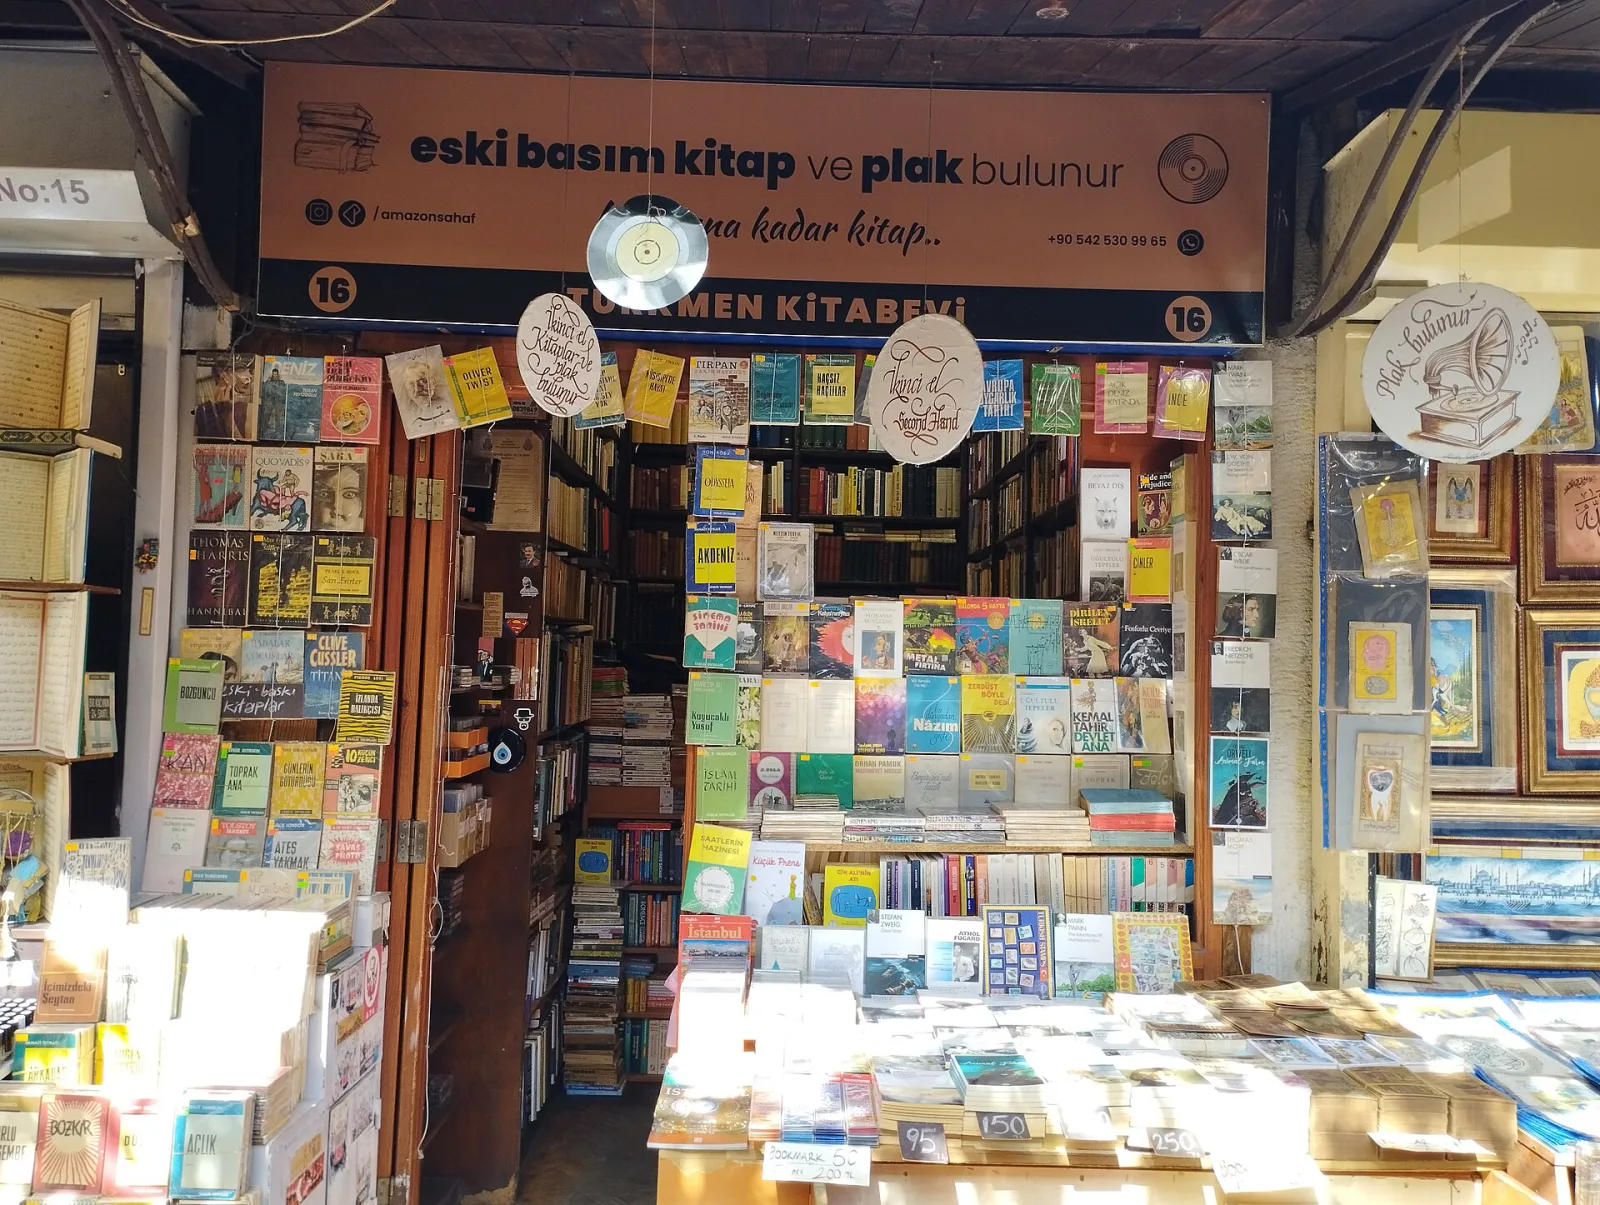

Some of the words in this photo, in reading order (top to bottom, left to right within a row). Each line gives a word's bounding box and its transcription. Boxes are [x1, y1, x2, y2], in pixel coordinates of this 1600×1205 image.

[410, 128, 508, 168] eski
[517, 132, 665, 174] basım
[674, 137, 795, 190] kitap
[807, 155, 853, 181] ve
[861, 148, 964, 193] plak
[972, 153, 1124, 188] bulunur
[0, 177, 90, 205] No:15
[373, 205, 476, 225] /amazonsahaf
[751, 206, 838, 243] kadar
[1047, 234, 1073, 245] +90
[1076, 234, 1101, 246] 542
[1103, 234, 1128, 247] 530
[1131, 235, 1148, 247] 99
[1151, 235, 1167, 248] 65
[314, 277, 350, 304] 16
[1172, 306, 1206, 333] 16
[1376, 350, 1420, 400] Plak
[1398, 300, 1486, 353] bulunur
[696, 361, 738, 370] TIRPAN
[533, 362, 590, 405] bulunur
[893, 406, 930, 434] Second
[928, 406, 961, 433] Hand
[255, 457, 279, 466] QUO
[1159, 472, 1172, 481] and
[1088, 482, 1110, 490] BEYAZ
[190, 536, 244, 548] THOMAS
[196, 550, 249, 562] HARRIS
[698, 545, 735, 564] AKDENİZ
[187, 606, 247, 616] HANNIBAL
[693, 622, 729, 632] TARİHİ
[1124, 624, 1149, 634] Fosforlu
[1149, 624, 1171, 634] Cevriye
[318, 635, 348, 651] CLIVE
[309, 649, 357, 668] CUSSLER
[905, 652, 940, 664] METAL
[915, 661, 946, 672] FIRTINA
[223, 698, 285, 716] kitaplar
[691, 711, 730, 724] Kuyucaklı
[1073, 711, 1114, 722] KEMAL
[691, 720, 714, 732] Yusuf
[913, 717, 959, 732] Nâzım
[1074, 731, 1116, 742] DEVLET
[1081, 742, 1111, 752] ANA
[855, 760, 877, 768] ORHAN
[878, 760, 902, 768] PAMUK
[229, 765, 259, 778] TOPRAK
[227, 779, 243, 791] ANA
[700, 834, 745, 848] SAATLERİN
[752, 856, 776, 868] Küçük
[777, 856, 802, 867] Prens
[688, 923, 743, 939] İstanbul
[43, 978, 93, 993] İçimizdeki
[982, 1114, 1025, 1136] 150
[905, 1127, 937, 1153] 95
[1151, 1131, 1193, 1152] 250
[812, 1166, 842, 1180] 200
